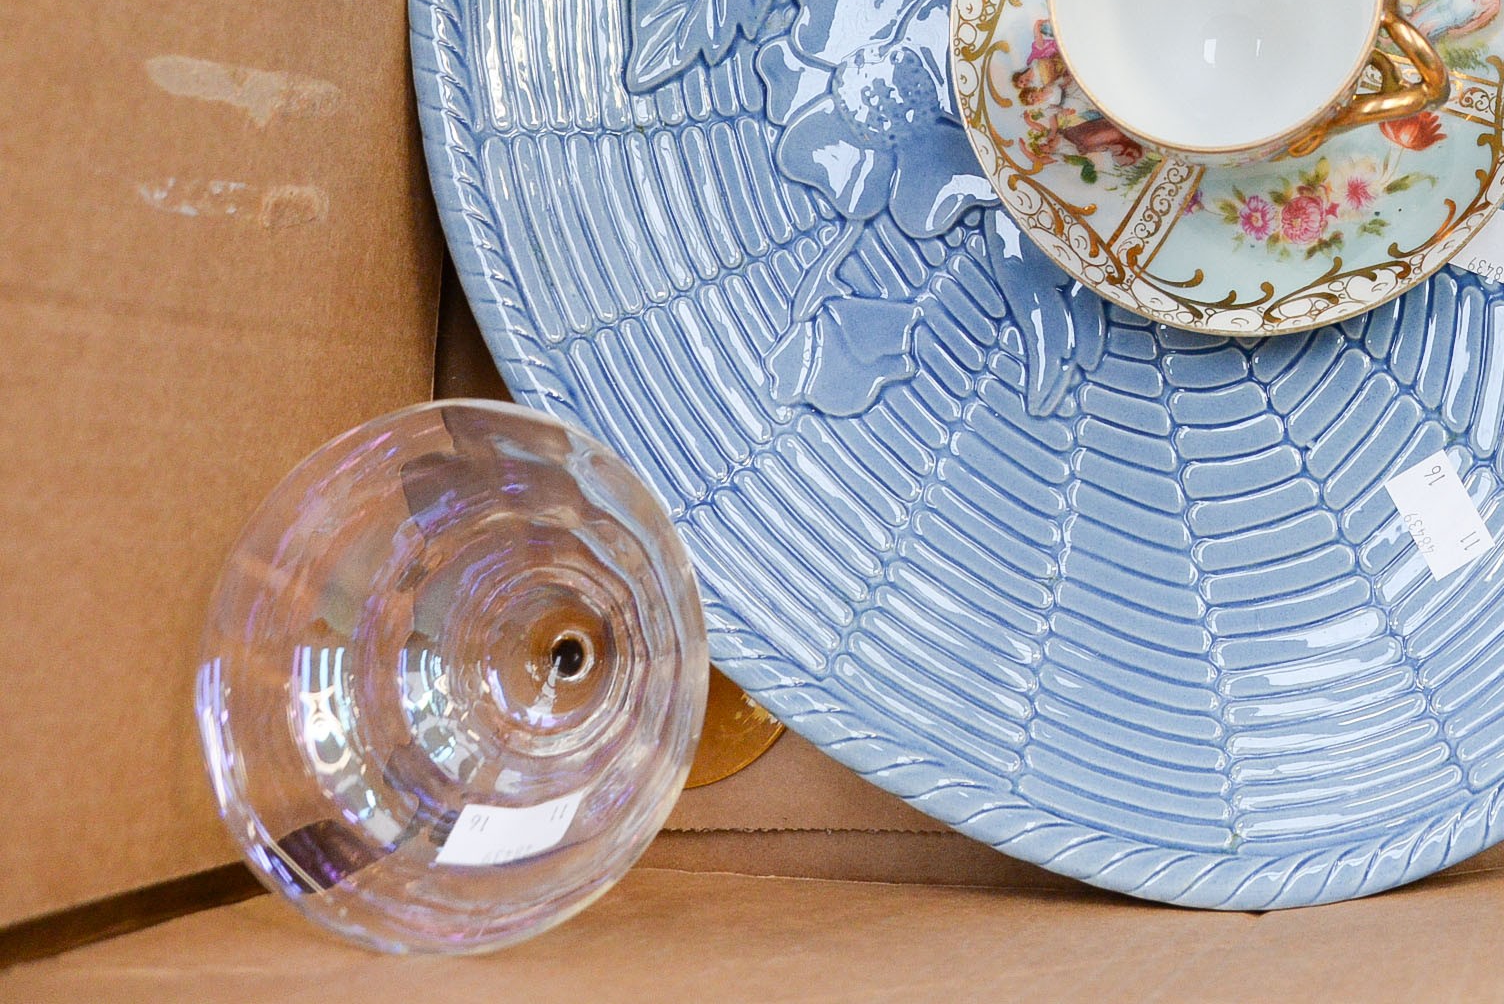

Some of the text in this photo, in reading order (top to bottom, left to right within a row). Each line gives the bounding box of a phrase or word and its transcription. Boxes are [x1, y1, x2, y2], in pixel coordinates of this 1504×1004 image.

[1424, 465, 1445, 486] 16
[1403, 513, 1434, 554] 48439
[1460, 531, 1480, 551] 11
